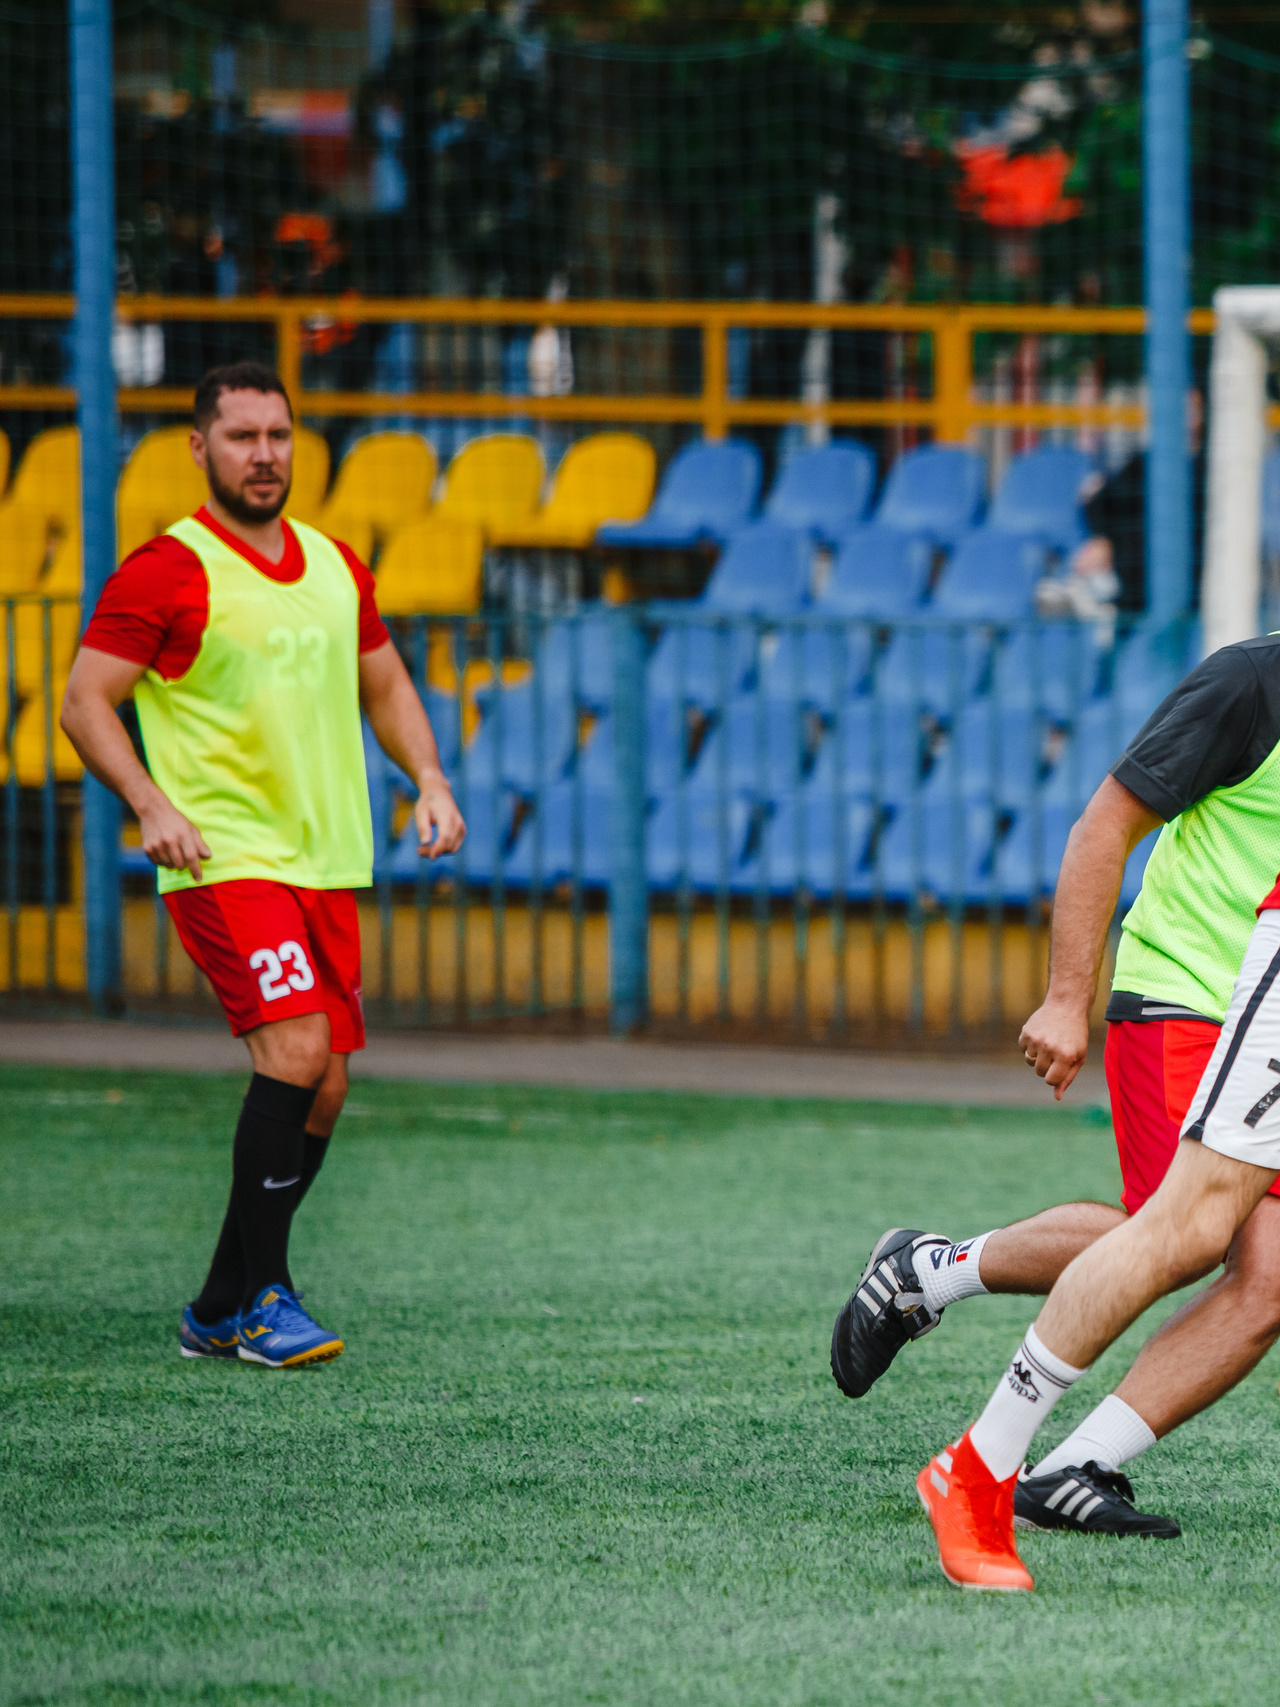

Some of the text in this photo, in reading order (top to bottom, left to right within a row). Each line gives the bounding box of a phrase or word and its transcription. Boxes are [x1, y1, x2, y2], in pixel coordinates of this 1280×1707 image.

[266, 625, 329, 690] 23
[249, 940, 315, 1002] 23
[929, 1237, 978, 1271] FILA
[1006, 1371, 1038, 1403] appa
